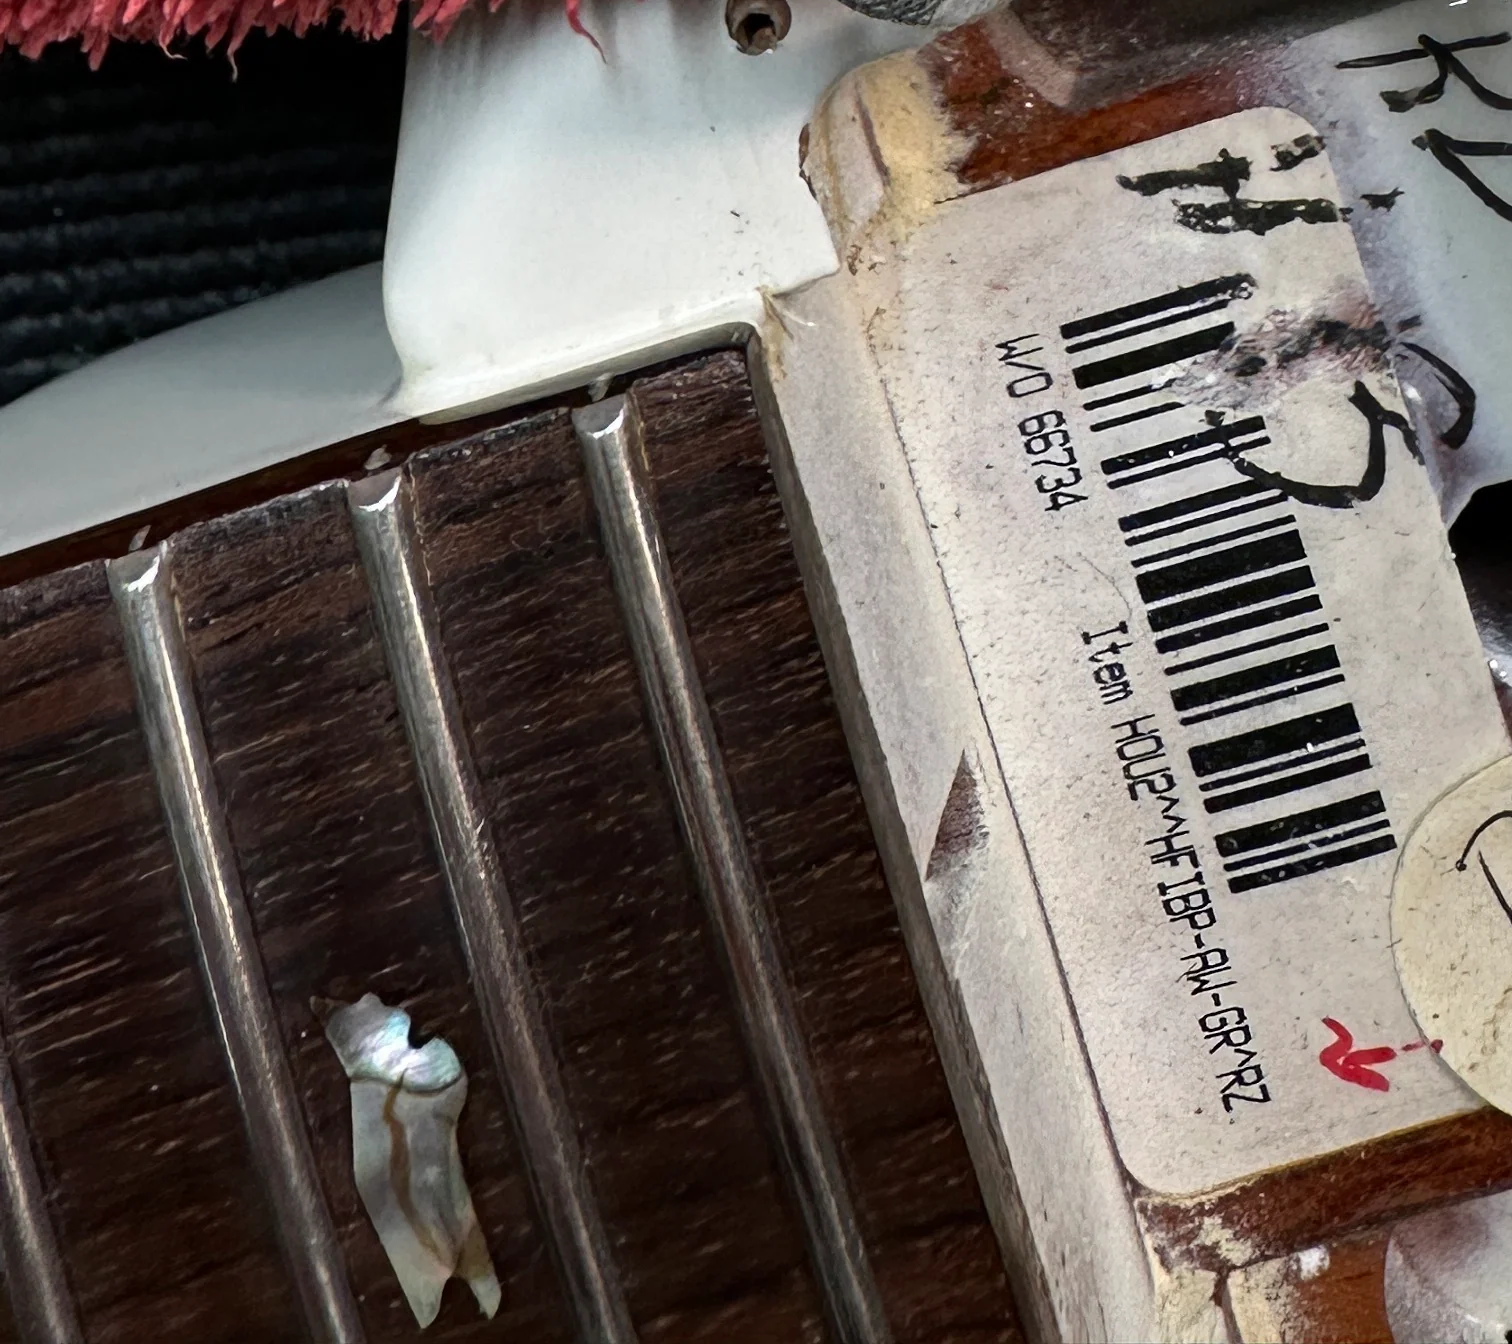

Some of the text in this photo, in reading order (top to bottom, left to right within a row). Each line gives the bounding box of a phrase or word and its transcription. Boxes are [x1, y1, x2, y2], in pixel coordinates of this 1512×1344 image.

[994, 332, 1055, 399] W/O
[1017, 409, 1089, 512] 66734
[1080, 620, 1134, 705] Item
